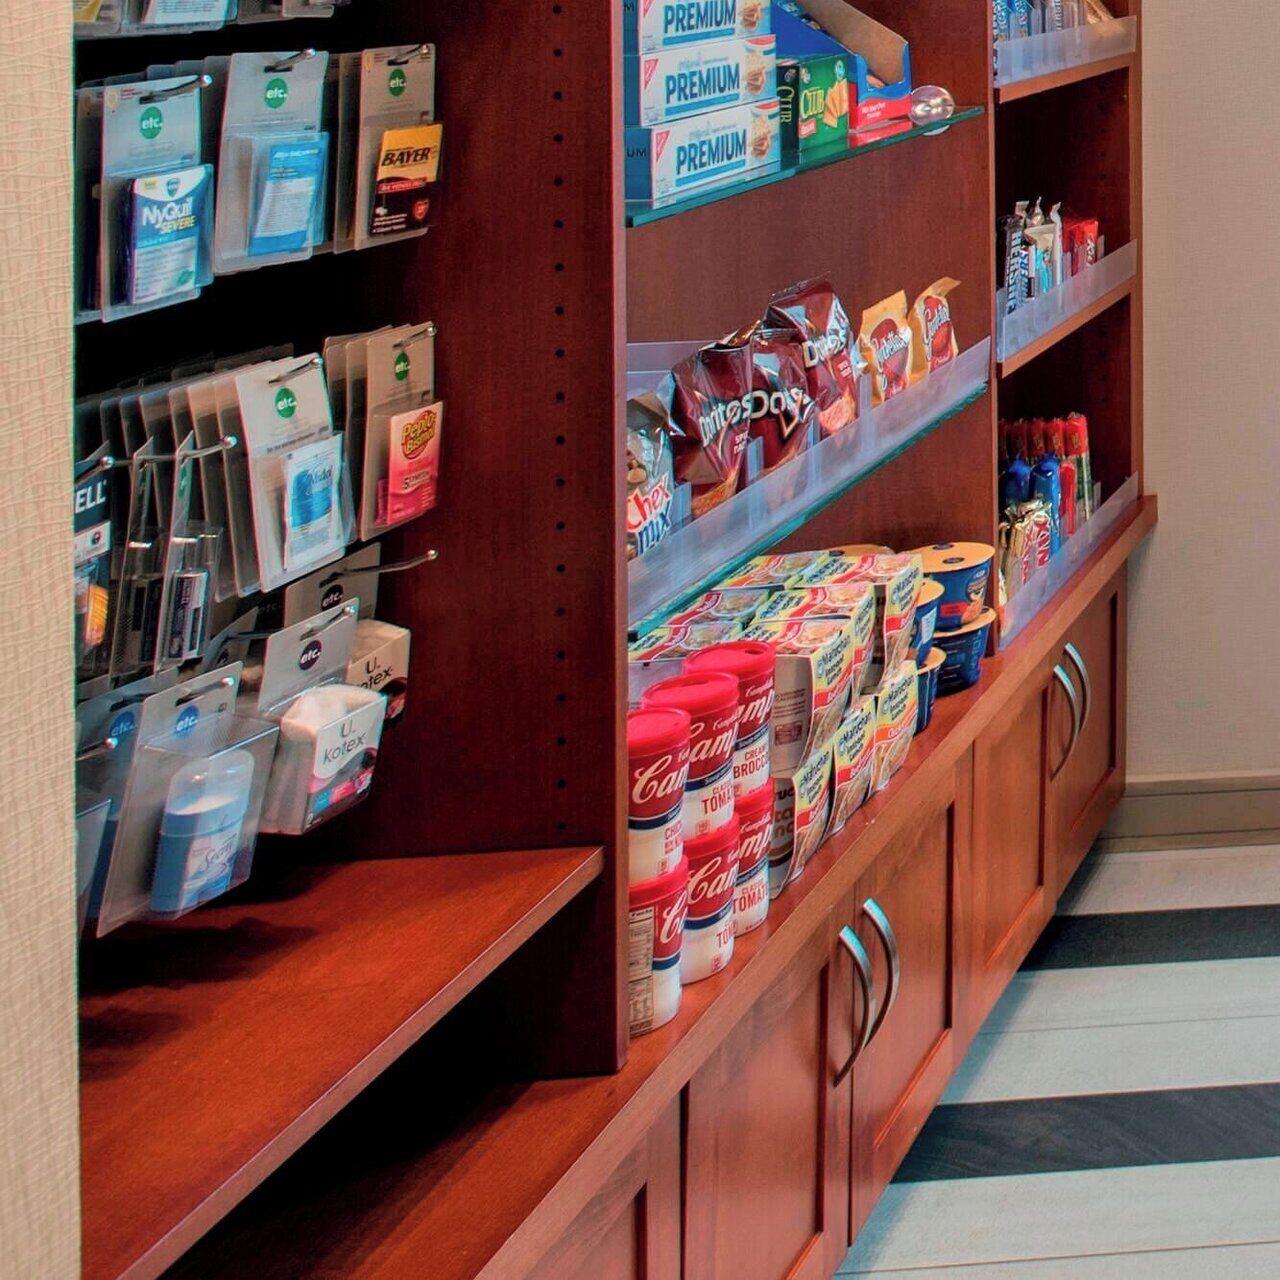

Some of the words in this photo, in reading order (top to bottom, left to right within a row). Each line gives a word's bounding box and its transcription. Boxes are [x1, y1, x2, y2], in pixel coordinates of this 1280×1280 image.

[265, 86, 289, 100] etc.
[388, 77, 407, 89] etc.
[664, 64, 740, 105] PREMIUM
[141, 115, 164, 131] etc.
[381, 146, 431, 167] BAYER
[675, 129, 748, 175] PREMIUM
[142, 196, 193, 229] NyQuil
[276, 395, 298, 411] etc.
[699, 396, 751, 447] Doritos
[627, 474, 670, 534] Chex
[320, 590, 344, 610] etc.
[299, 646, 321, 663] etc.
[817, 634, 851, 669] Maruchan
[360, 668, 394, 691] otex
[883, 676, 915, 709] Maruchan
[175, 714, 199, 733] etc.
[839, 711, 873, 749] Maruchan
